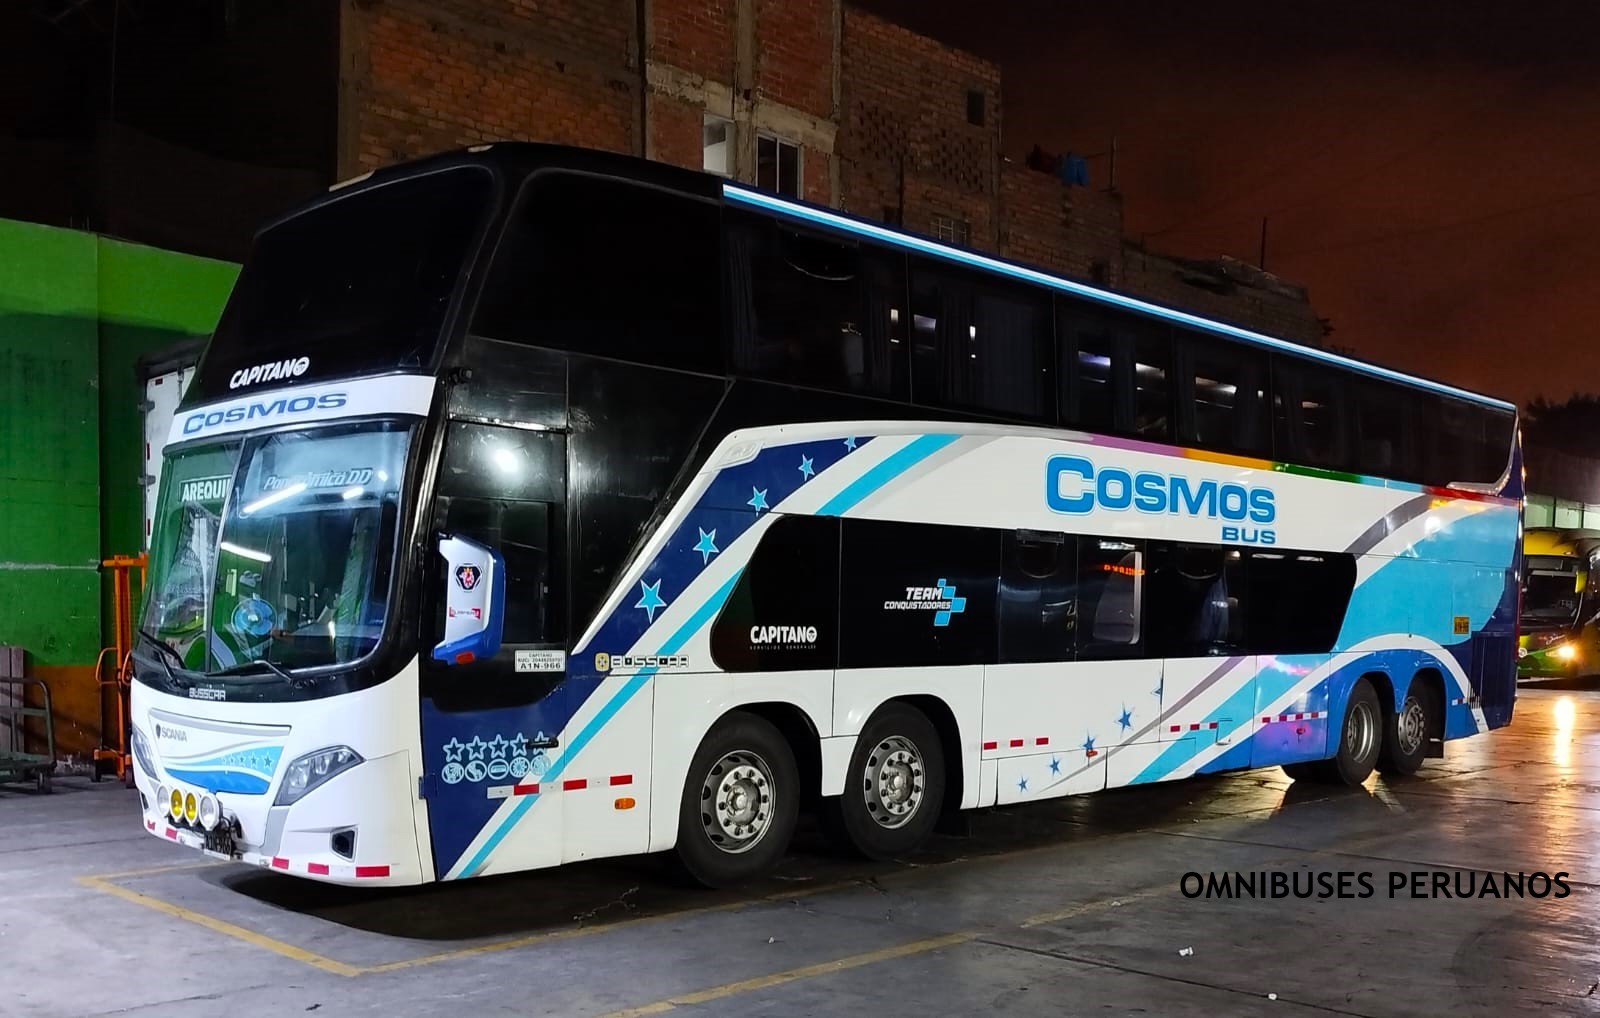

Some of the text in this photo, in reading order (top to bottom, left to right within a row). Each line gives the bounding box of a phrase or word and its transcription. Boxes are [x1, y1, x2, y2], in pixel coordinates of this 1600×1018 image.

[229, 356, 310, 389] CAPITANO
[1221, 526, 1276, 545] BUS
[906, 586, 943, 600] TEAM
[884, 600, 951, 610] CONQUISTADORES
[750, 625, 818, 643] CAPITANO
[188, 687, 226, 700] BUSSCAR
[162, 726, 187, 742] SCANIA
